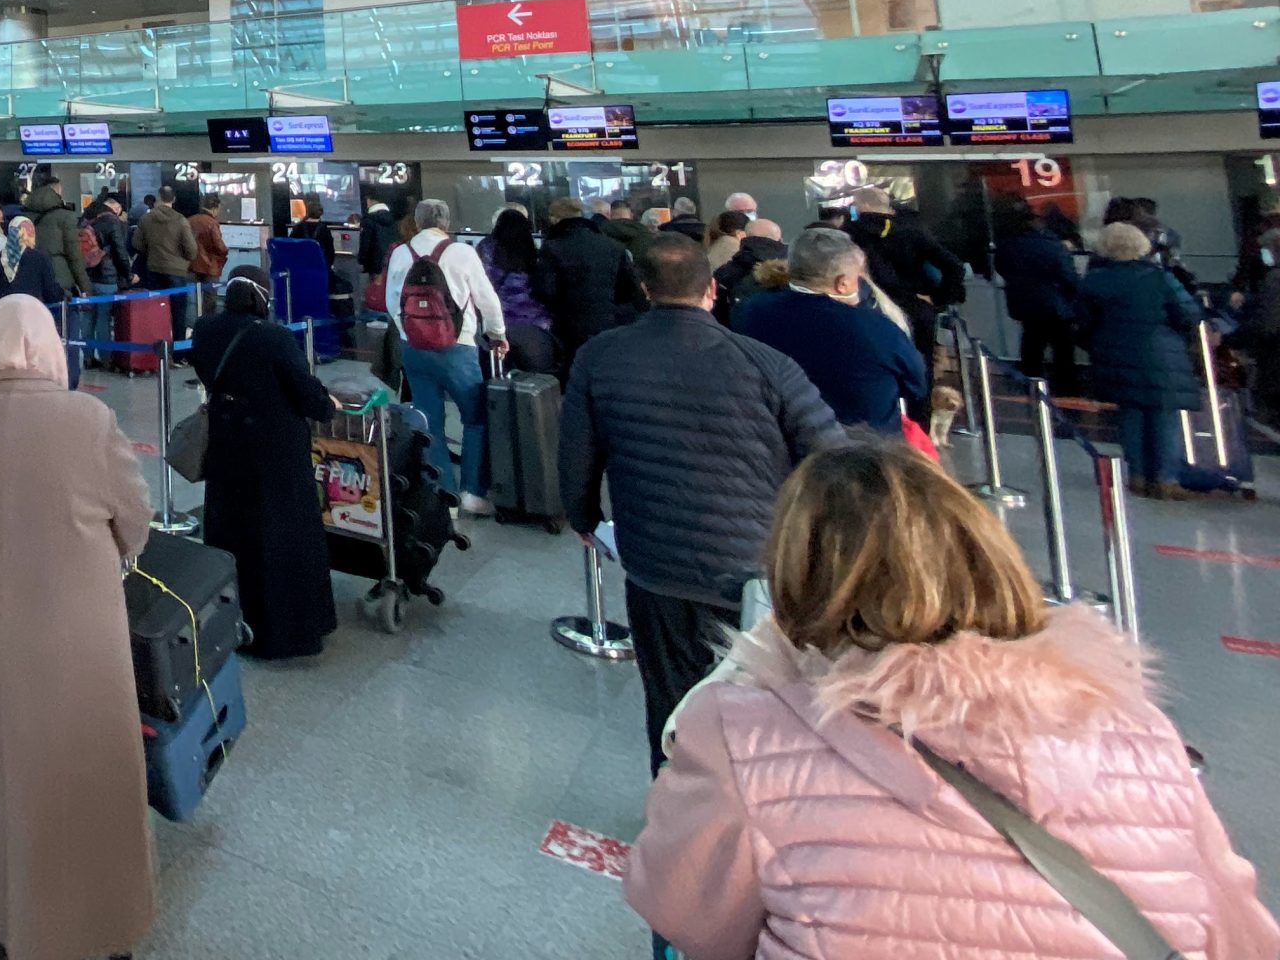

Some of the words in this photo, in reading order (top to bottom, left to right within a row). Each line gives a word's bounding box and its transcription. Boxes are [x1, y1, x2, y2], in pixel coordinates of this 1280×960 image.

[486, 34, 506, 43] PCR
[507, 33, 525, 41] Test
[526, 31, 558, 40] Noktası
[491, 43, 511, 53] PCR
[513, 42, 531, 51] Test
[532, 41, 554, 50] Point
[19, 163, 37, 179] 27
[96, 163, 116, 179] 26
[175, 162, 198, 181] 25
[272, 163, 298, 183] 24
[378, 163, 408, 184] 23
[508, 162, 543, 186] 22
[651, 162, 686, 187] 21
[1011, 159, 1061, 187] 19
[1254, 154, 1277, 185] 1
